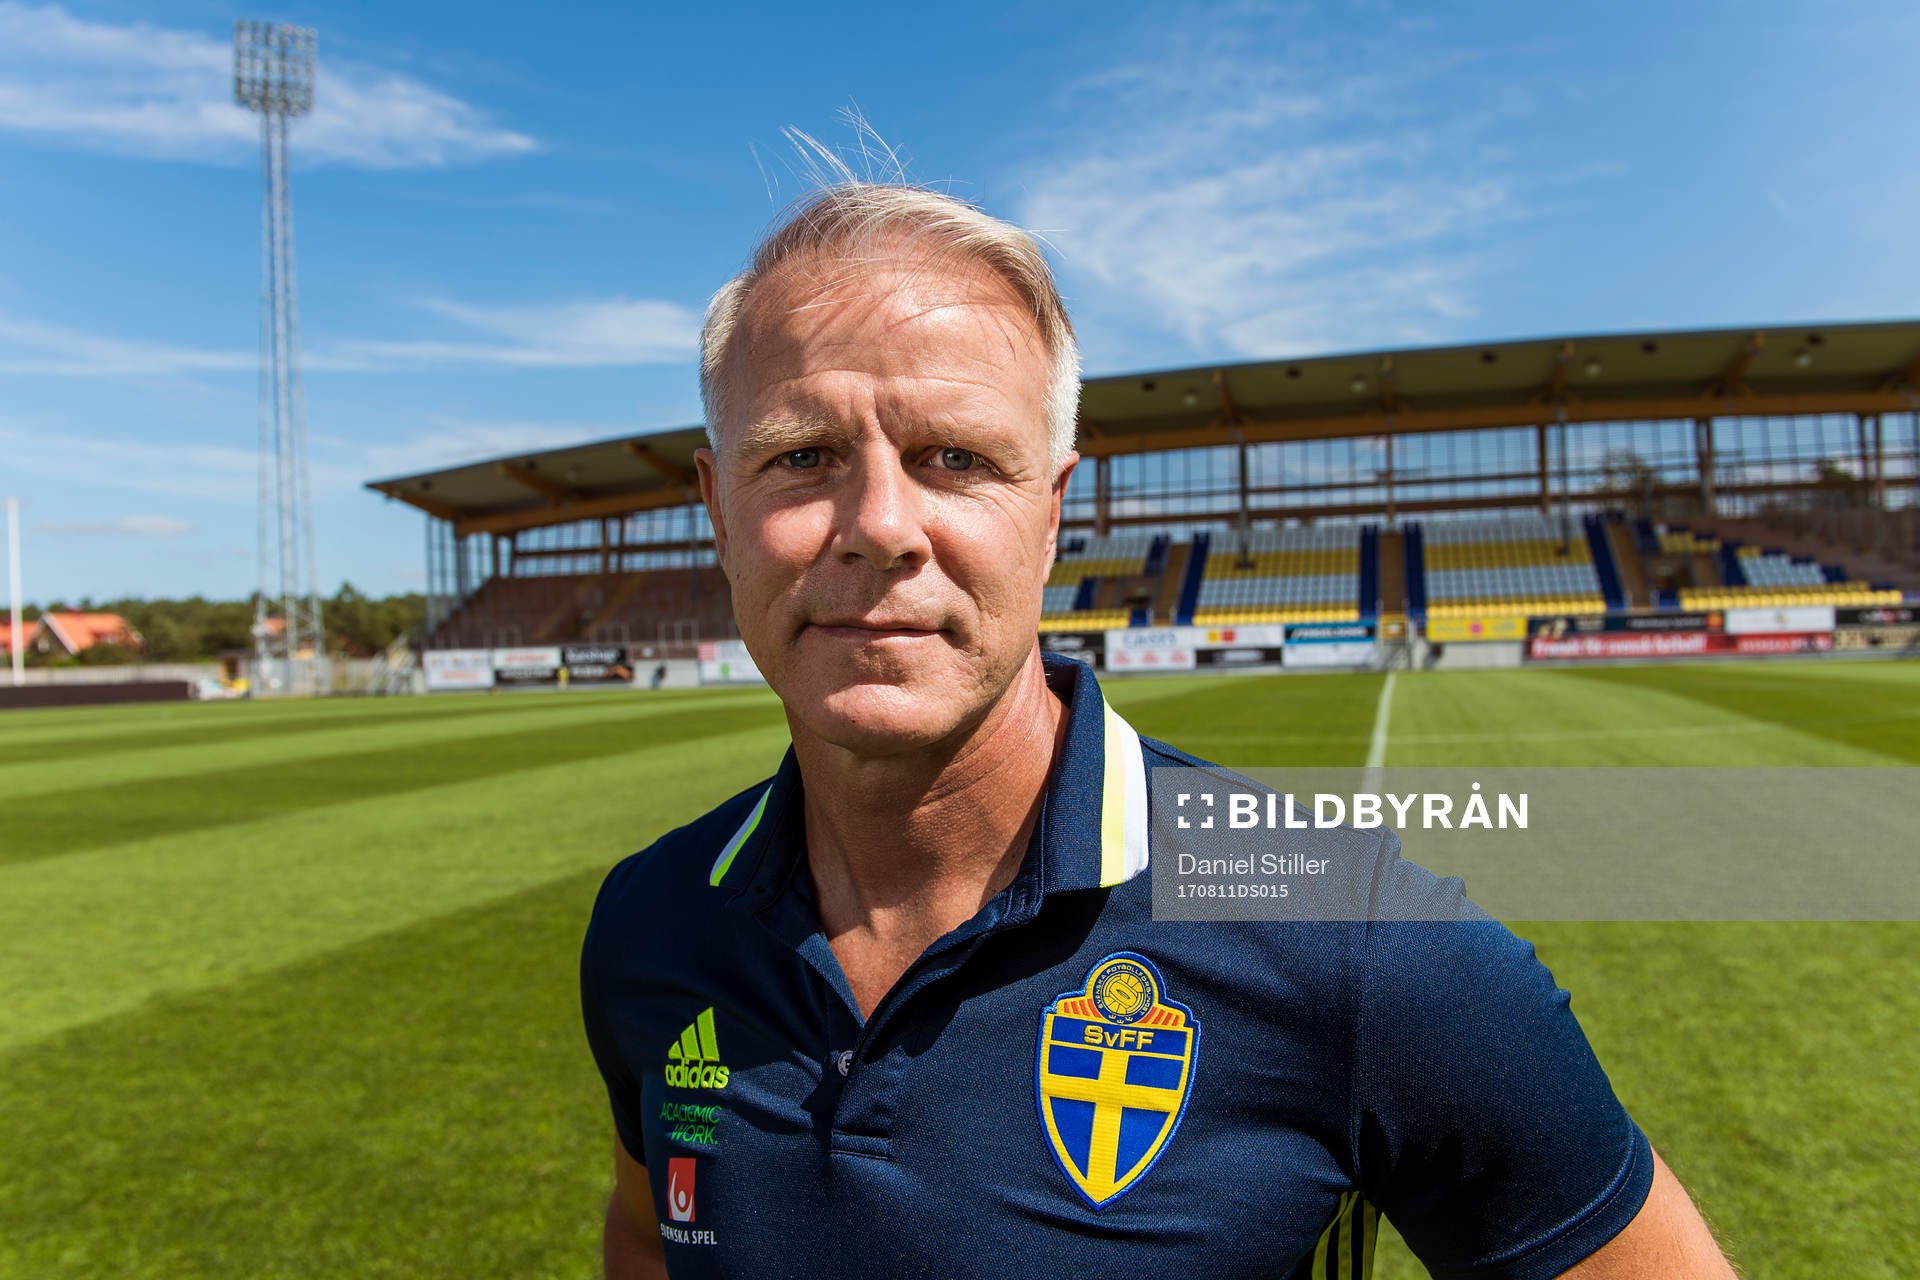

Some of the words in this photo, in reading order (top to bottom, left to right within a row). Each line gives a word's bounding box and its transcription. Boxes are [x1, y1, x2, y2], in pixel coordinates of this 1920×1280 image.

[1083, 1025, 1155, 1050] SvFF
[665, 1058, 730, 1089] adidas
[660, 1102, 723, 1124] ACADEMIC
[691, 1230, 718, 1245] SPEL
